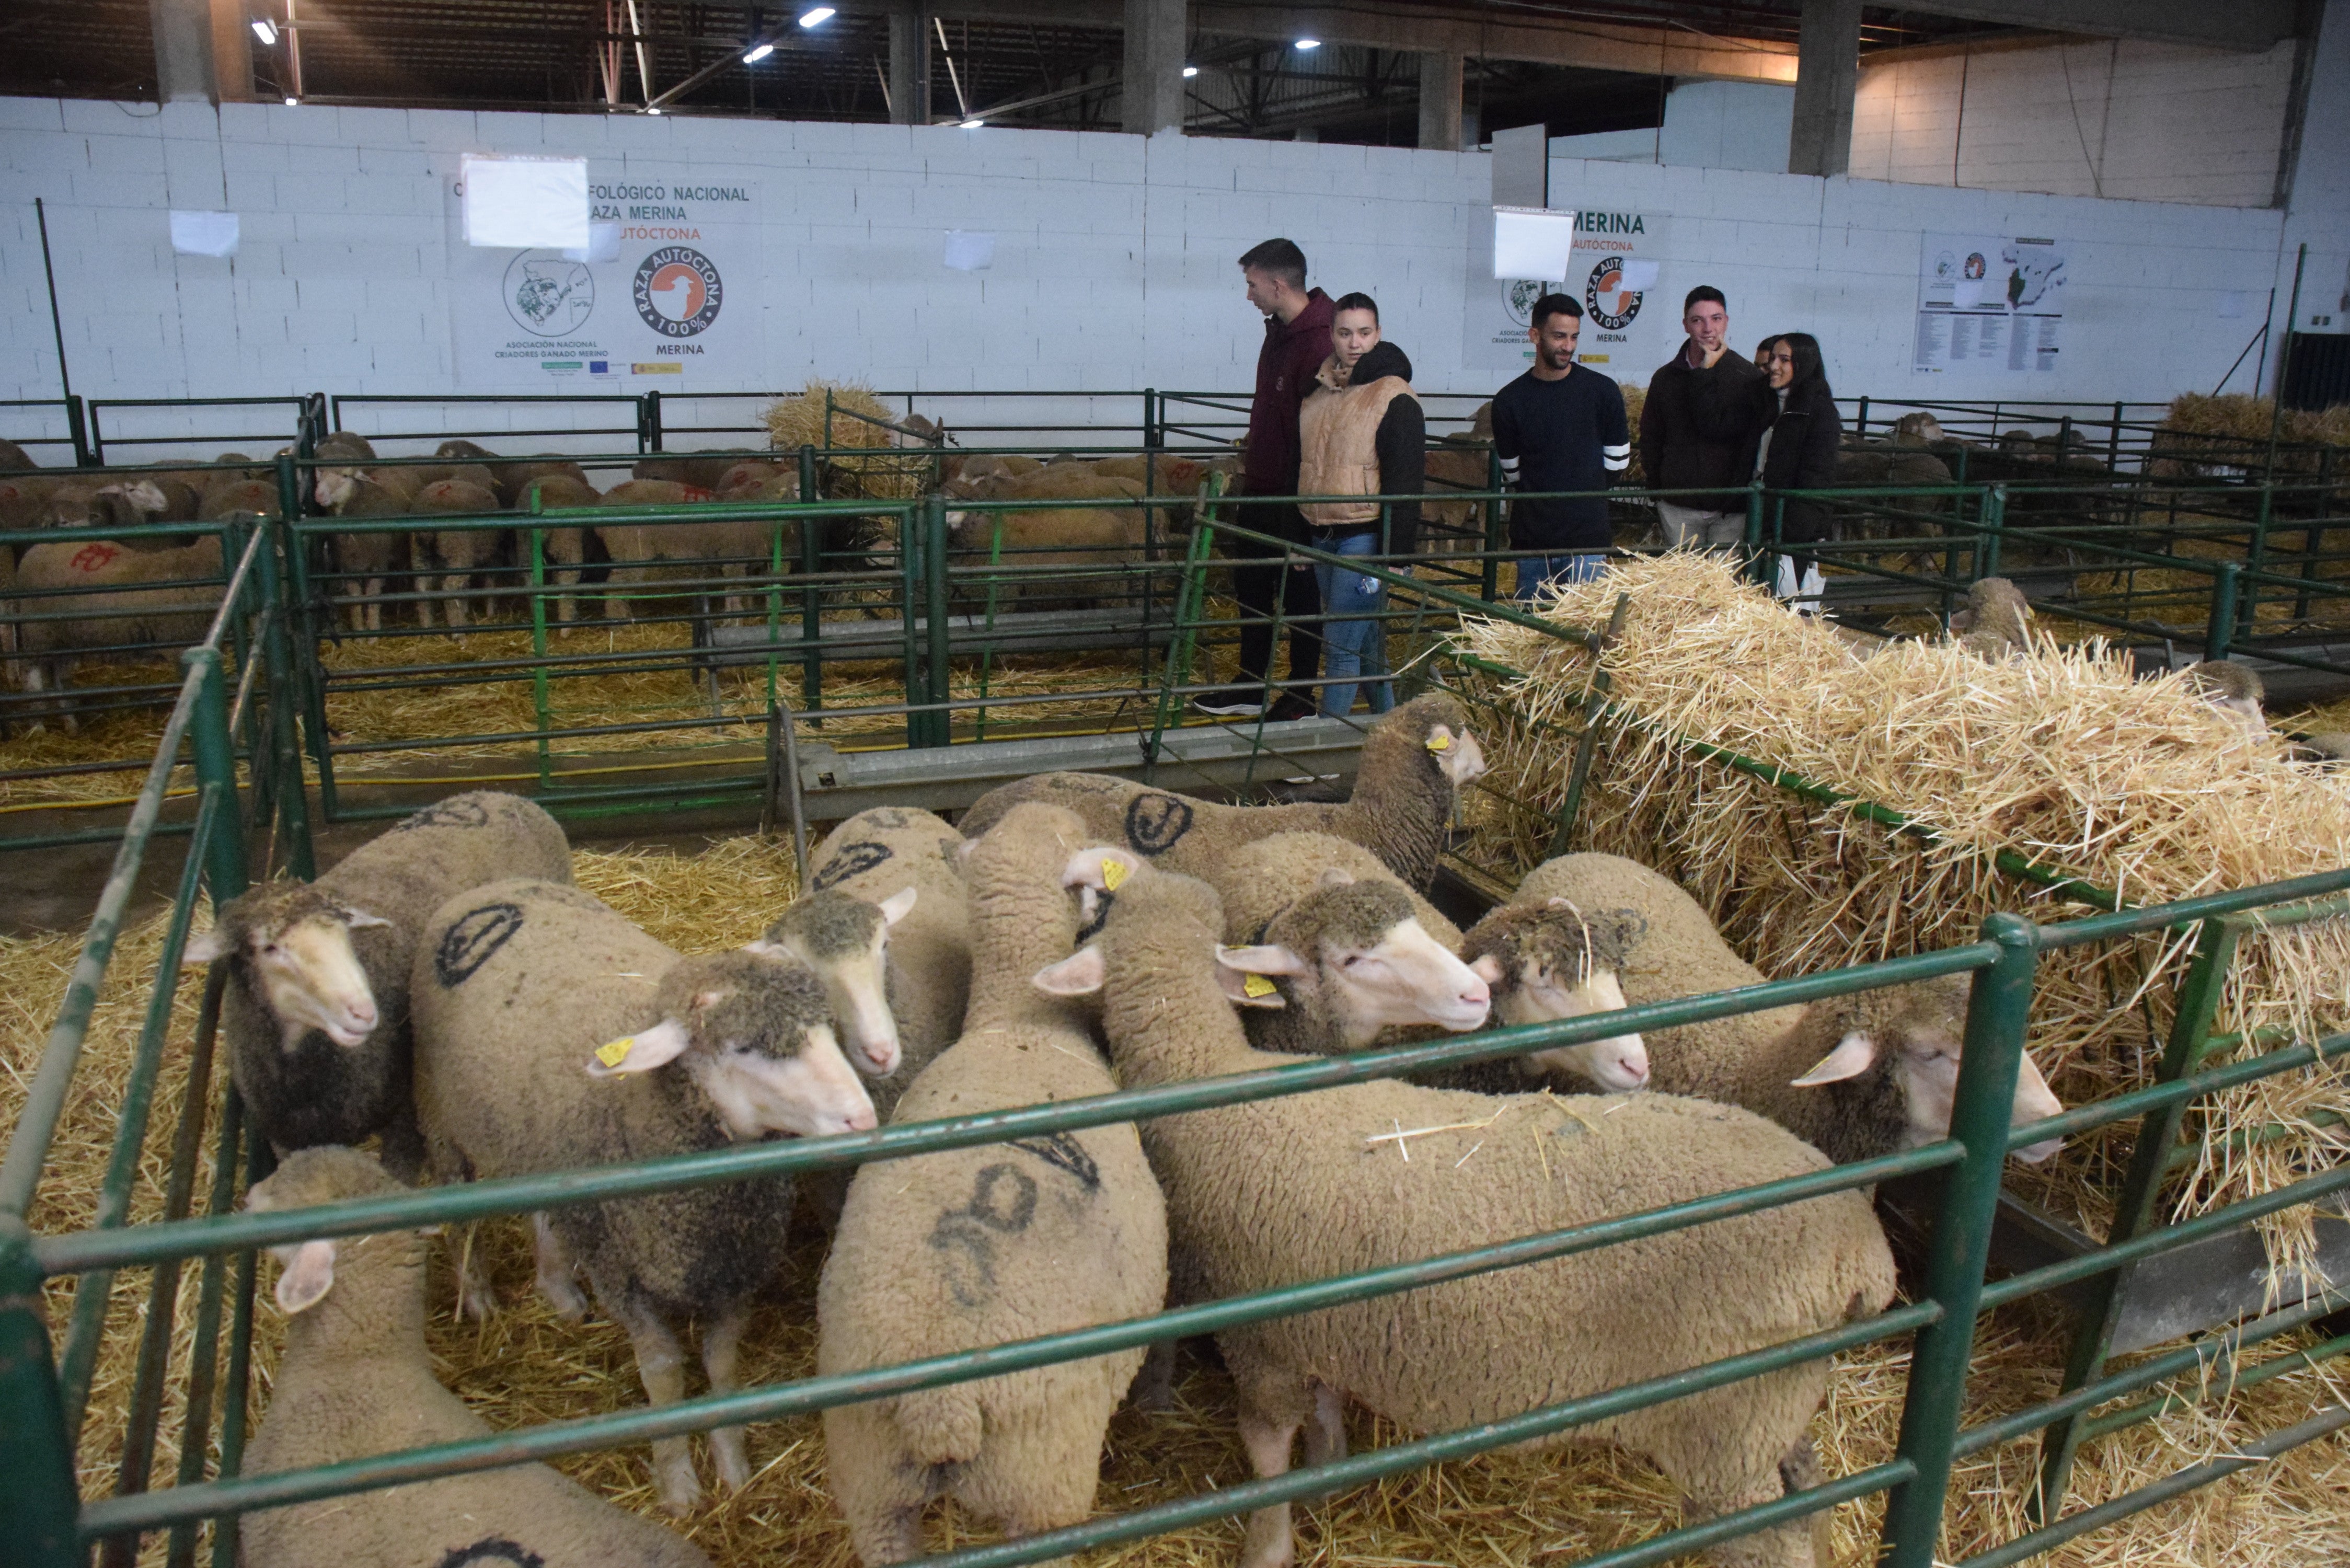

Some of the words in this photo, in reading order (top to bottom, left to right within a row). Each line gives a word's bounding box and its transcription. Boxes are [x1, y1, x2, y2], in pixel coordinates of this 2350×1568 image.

[589, 182, 665, 200] FOLÓGICO
[674, 186, 750, 201] NACIONAL
[591, 205, 621, 219] AZA
[629, 205, 687, 220] MERINA
[620, 225, 701, 240] UTÓCTONA
[1572, 238, 1634, 251] AUTÓCTONA
[635, 269, 652, 313] RAZA
[653, 249, 720, 306] AUTÓCTONA
[1587, 274, 1600, 309] RAZA
[658, 316, 707, 335] 100%
[1598, 313, 1631, 328] 100%
[506, 340, 555, 349] ASOCIACIÓN
[1596, 334, 1628, 342] MERINA
[656, 345, 705, 355] MERINA
